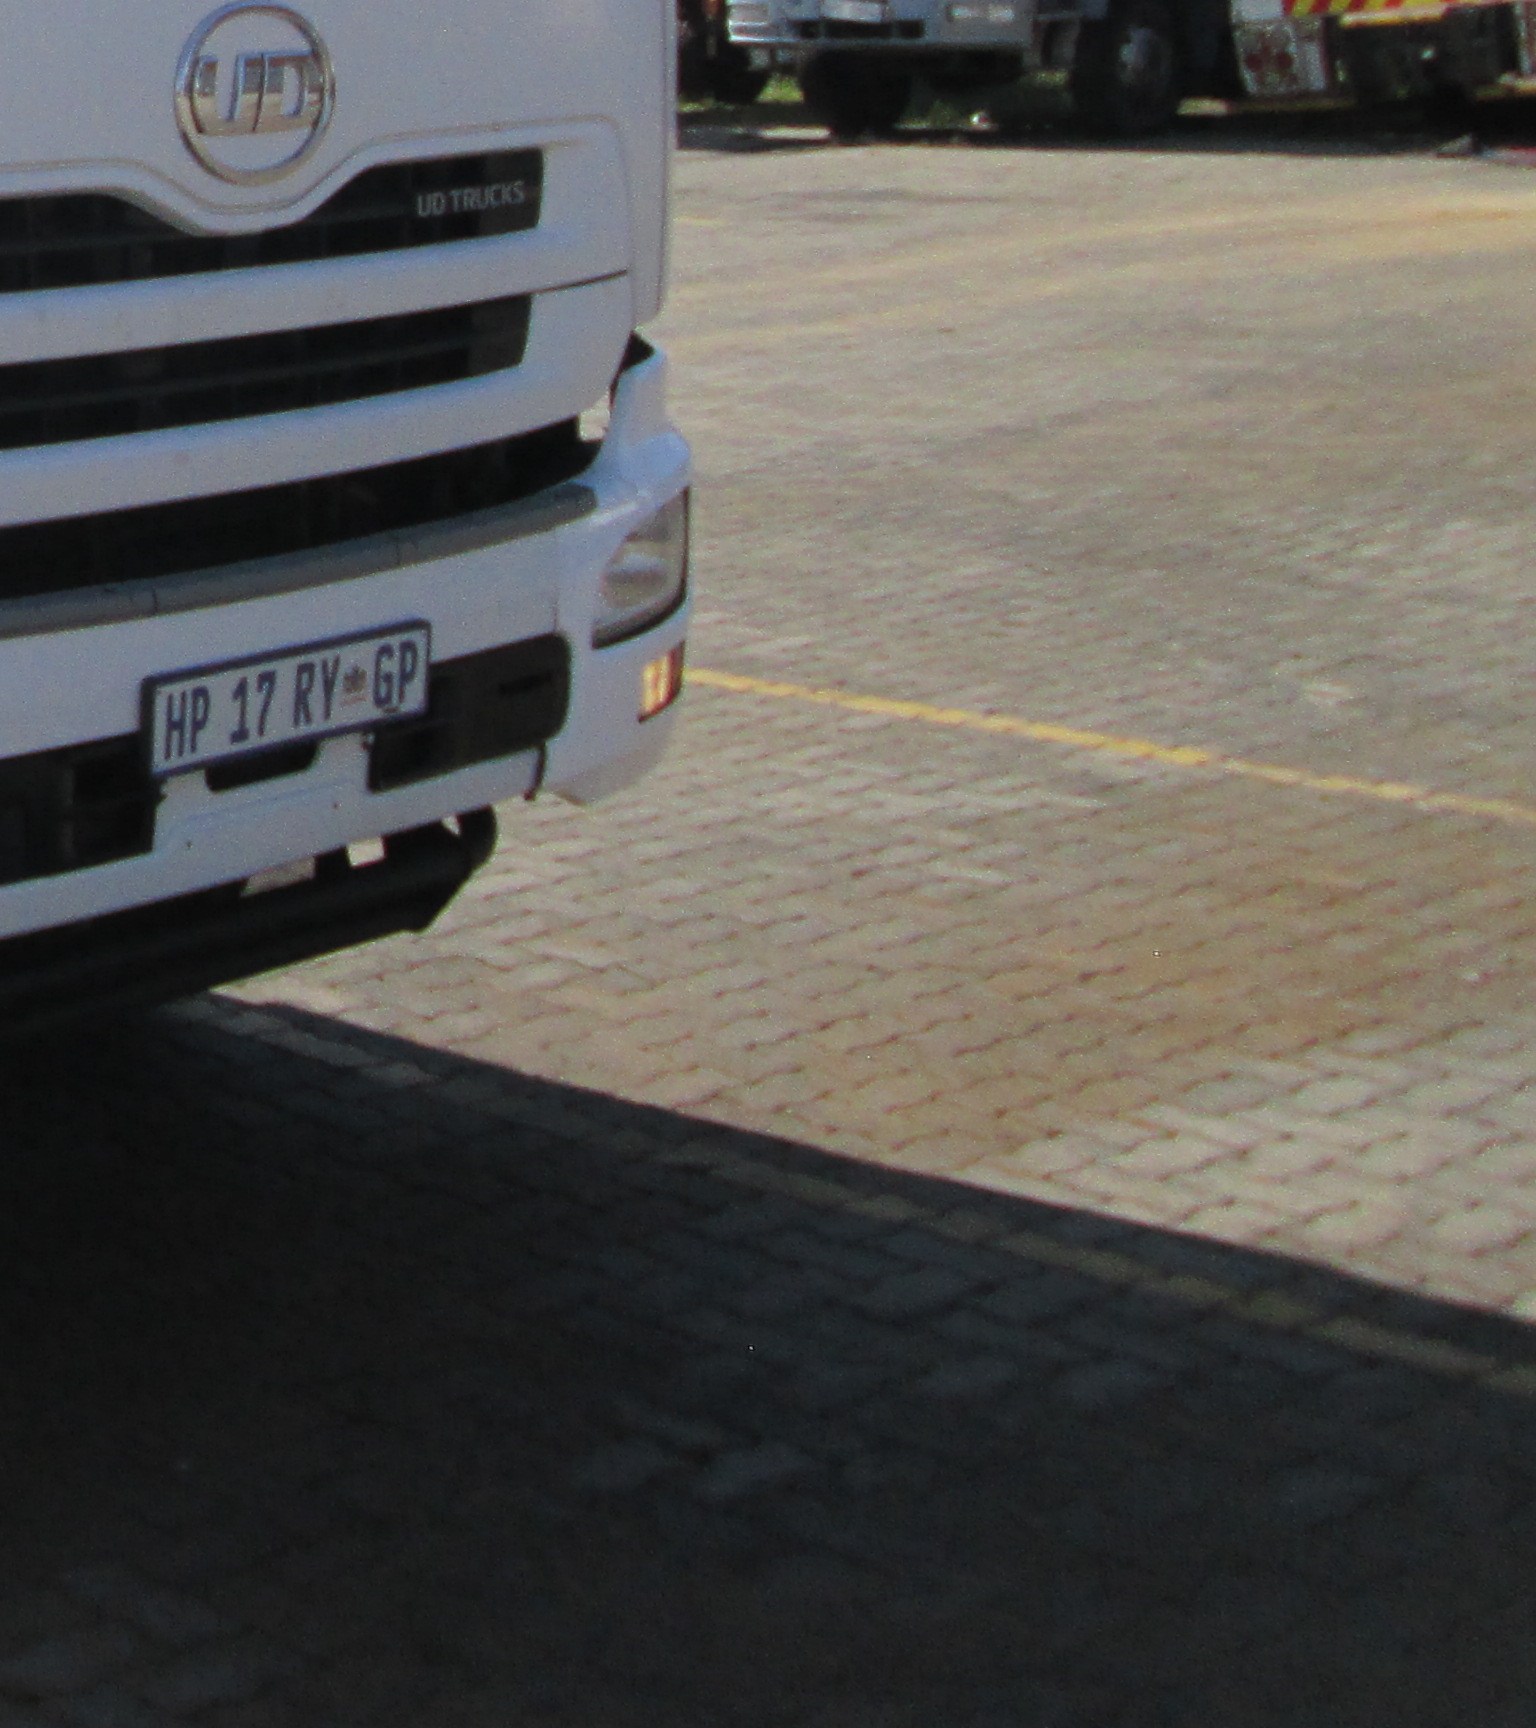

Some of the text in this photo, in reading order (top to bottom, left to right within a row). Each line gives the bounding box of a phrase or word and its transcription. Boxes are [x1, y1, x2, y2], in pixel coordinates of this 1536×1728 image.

[416, 180, 526, 218] UD TRUCKS
[163, 639, 419, 761] HP 17 RY GP
